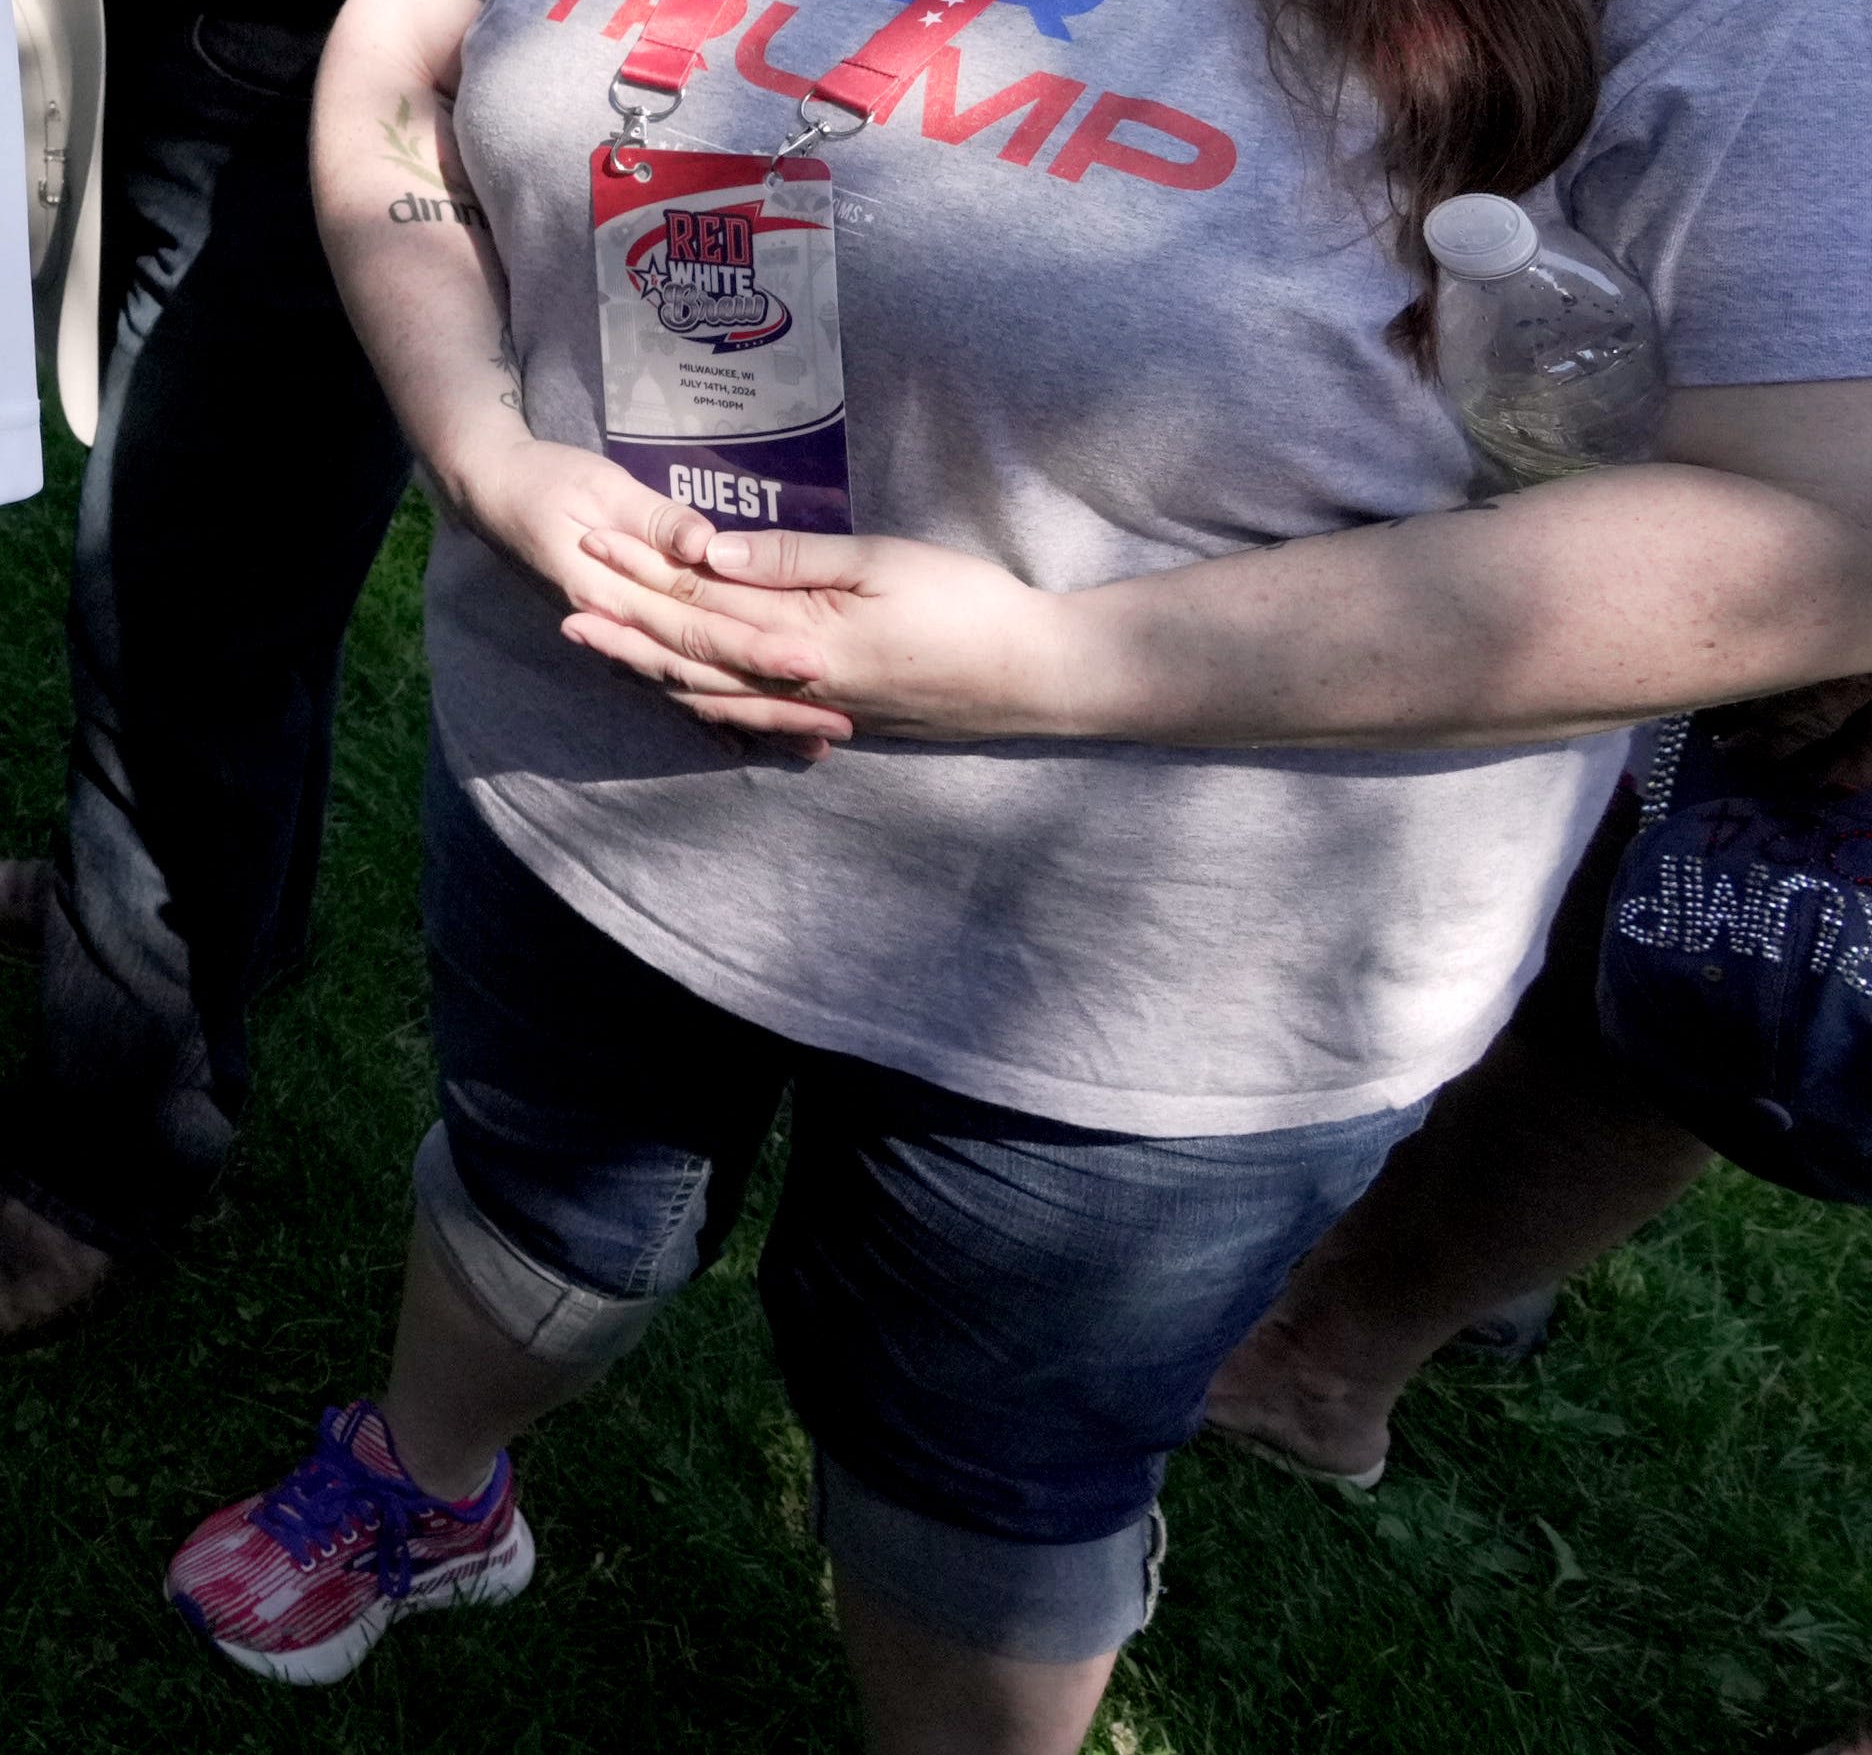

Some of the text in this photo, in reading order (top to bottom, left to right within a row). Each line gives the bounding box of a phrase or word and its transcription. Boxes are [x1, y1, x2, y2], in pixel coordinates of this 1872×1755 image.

[667, 212, 753, 266] RED
[667, 259, 754, 296] WHITE
[660, 283, 767, 331] Brew
[679, 362, 754, 382] MILWAUKEE, WI
[680, 378, 756, 397] JULY 14TH, 2024
[693, 396, 744, 411] 6PM-10PM
[669, 463, 783, 523] GUEST
